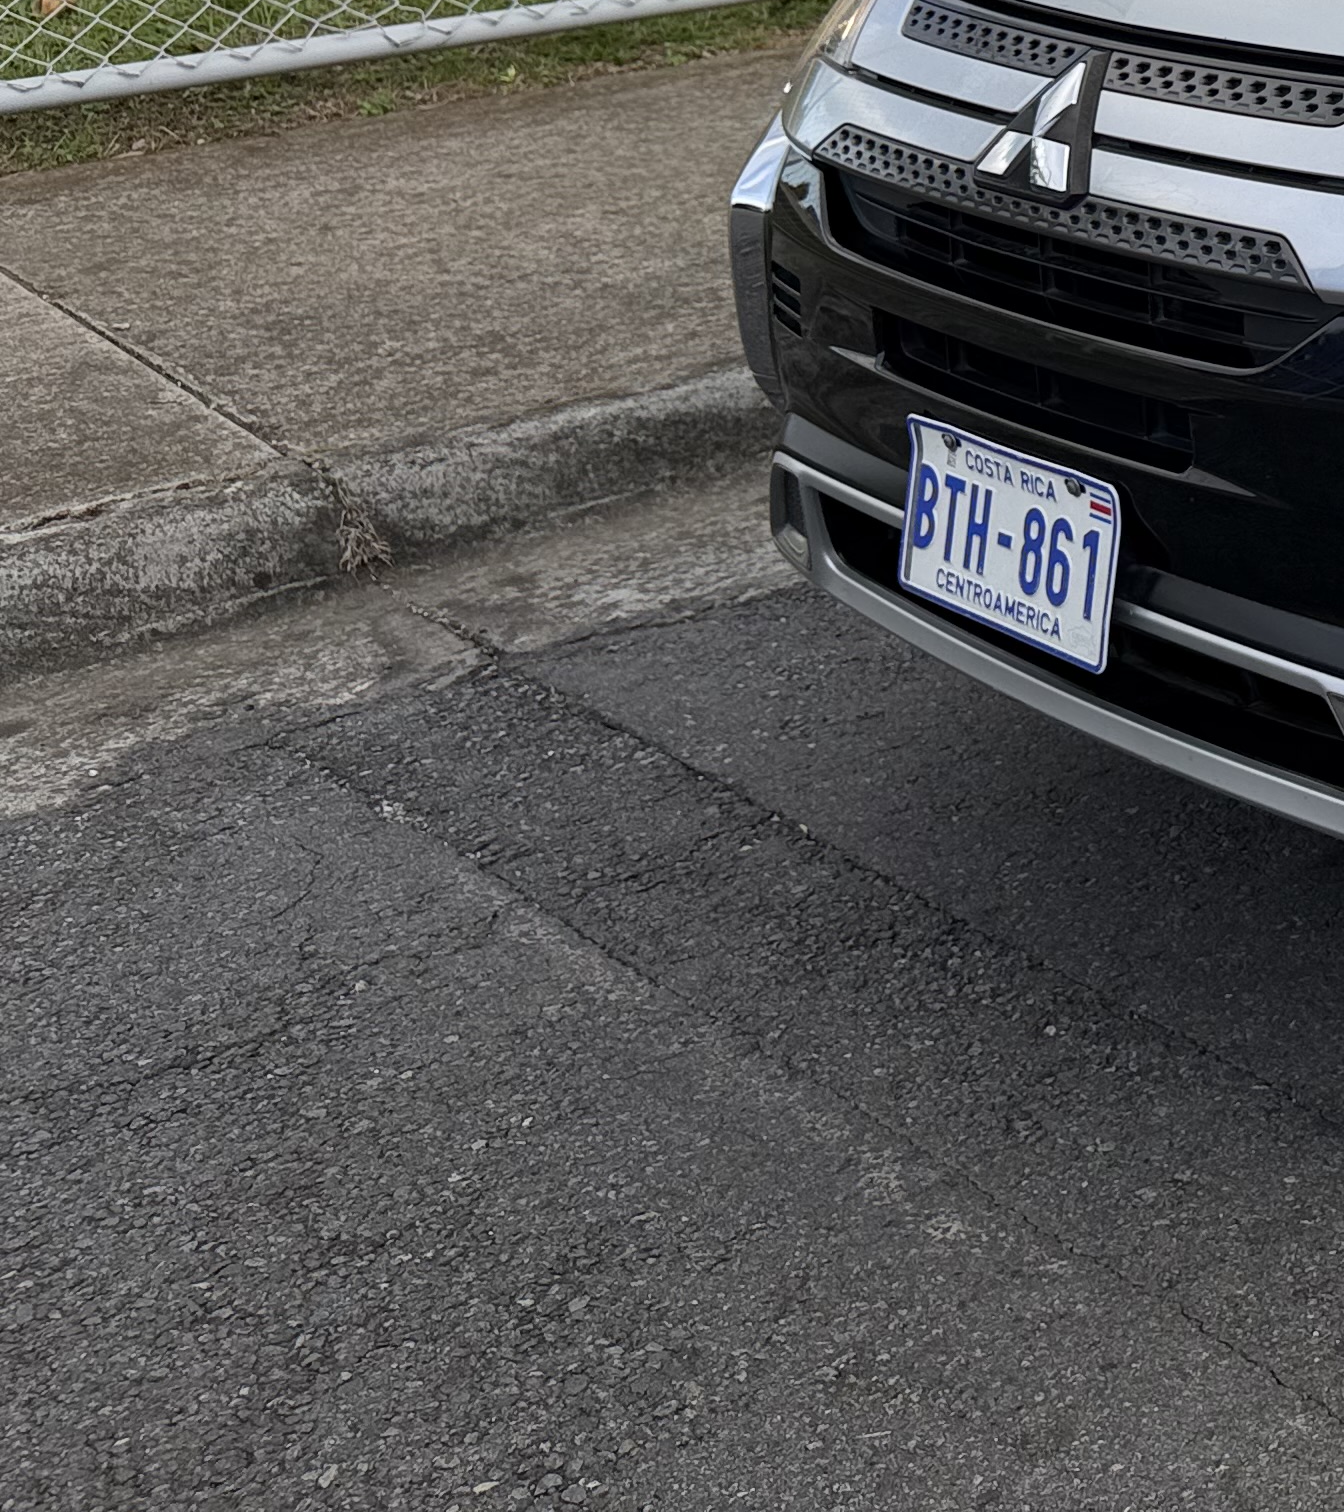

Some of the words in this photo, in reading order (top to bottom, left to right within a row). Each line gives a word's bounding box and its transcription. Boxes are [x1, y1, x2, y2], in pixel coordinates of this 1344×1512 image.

[964, 449, 1015, 487] COSTA
[1019, 470, 1058, 503] RICA
[912, 461, 1102, 622] BTH-861
[935, 567, 1063, 642] CENTROAMERICA
